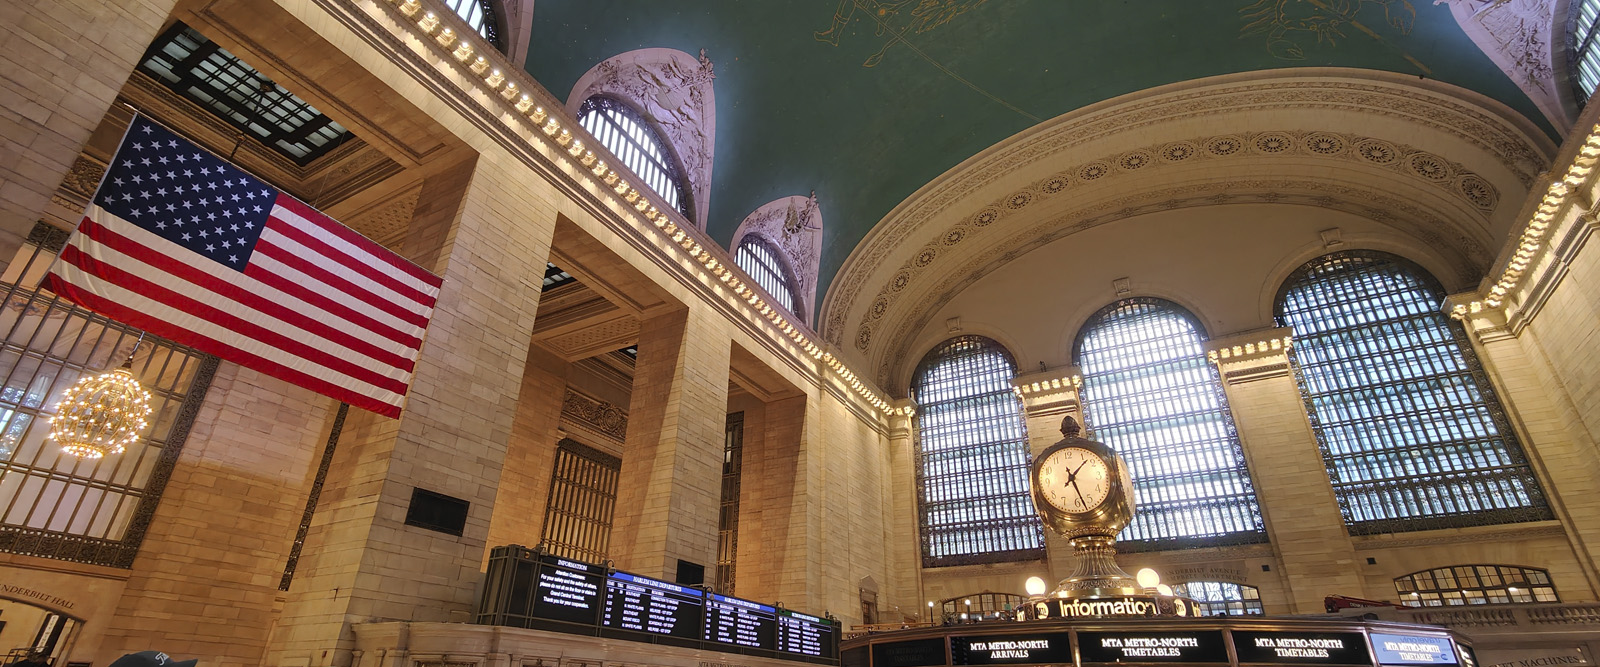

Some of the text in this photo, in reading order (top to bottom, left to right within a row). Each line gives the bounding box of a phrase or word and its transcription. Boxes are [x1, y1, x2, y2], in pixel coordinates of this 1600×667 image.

[1064, 451, 1073, 459] 12
[1053, 456, 1059, 465] 11
[1090, 458, 1096, 467] 2
[1045, 466, 1052, 476] 10
[1096, 470, 1102, 480] 3
[1045, 478, 1050, 486] 9
[1095, 484, 1101, 493] 4
[1051, 490, 1056, 499] 8
[1087, 494, 1093, 504] 5
[1060, 496, 1066, 506] 7
[1074, 498, 1081, 508] 6
[558, 560, 588, 570] INFORMATION
[51, 597, 74, 609] HALL
[1059, 598, 1158, 618] Information
[970, 640, 1049, 651] MTA METRO-NORTH
[1102, 638, 1198, 648] MTA METRO-NORTH
[1255, 638, 1344, 649] MTA METRO-NORTH
[1384, 642, 1440, 653] MTA METRO-NORTH
[991, 650, 1030, 659] ARRIVALS
[1122, 648, 1181, 657] TIMETABLES
[1274, 648, 1330, 658] TIMETABLES
[1518, 656, 1580, 667] MACHINES
